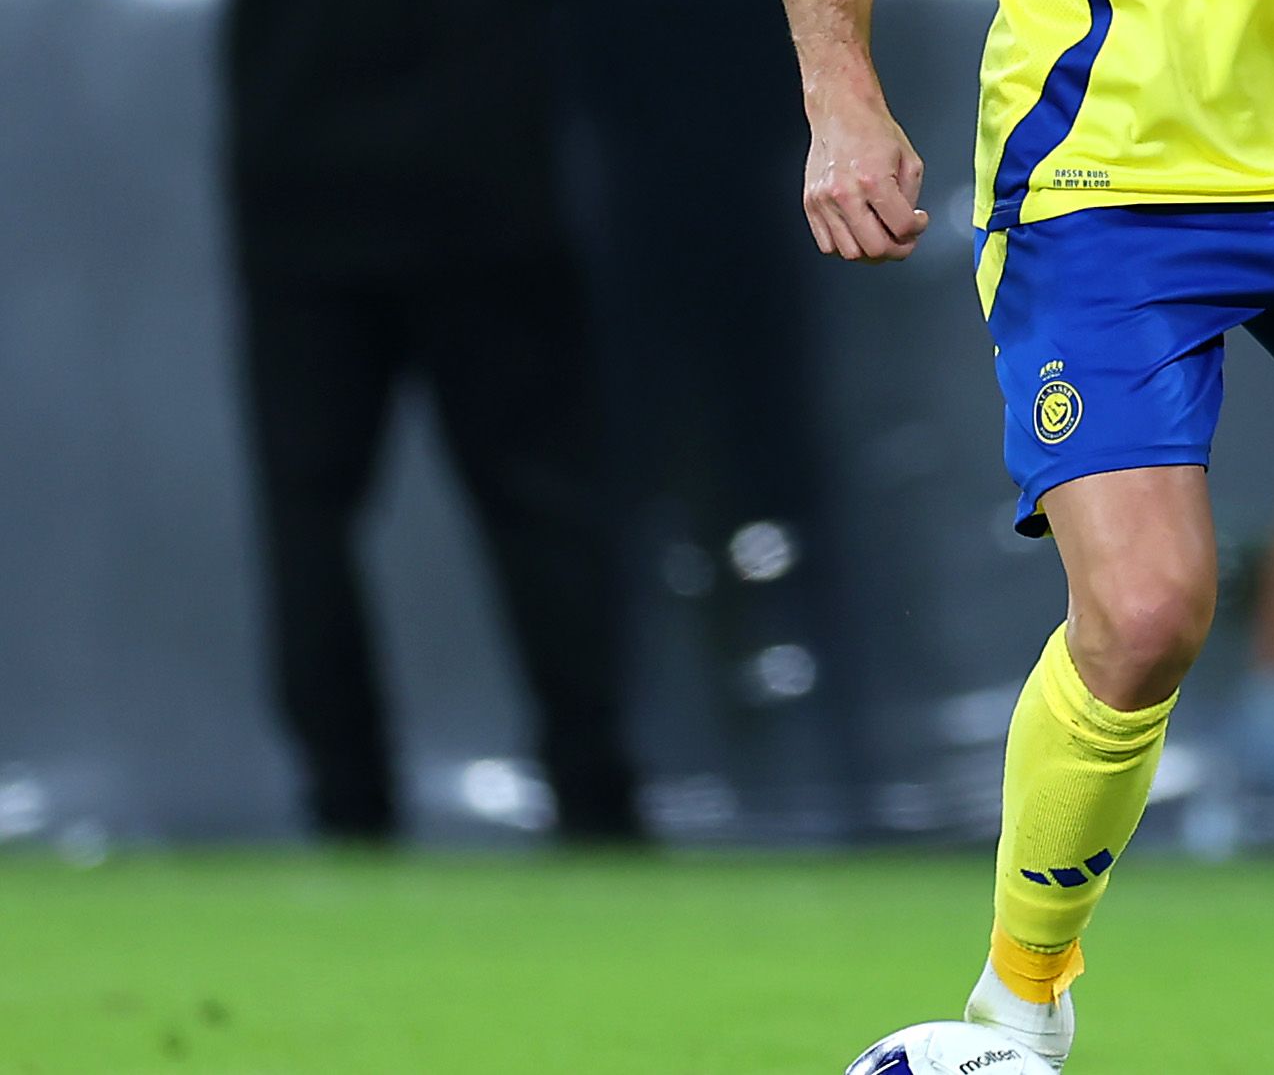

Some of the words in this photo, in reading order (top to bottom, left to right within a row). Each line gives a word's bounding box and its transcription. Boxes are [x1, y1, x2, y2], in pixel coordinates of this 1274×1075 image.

[1065, 179, 1080, 188] MY
[1083, 180, 1111, 188] BLOOD
[959, 1048, 1021, 1075] molten
